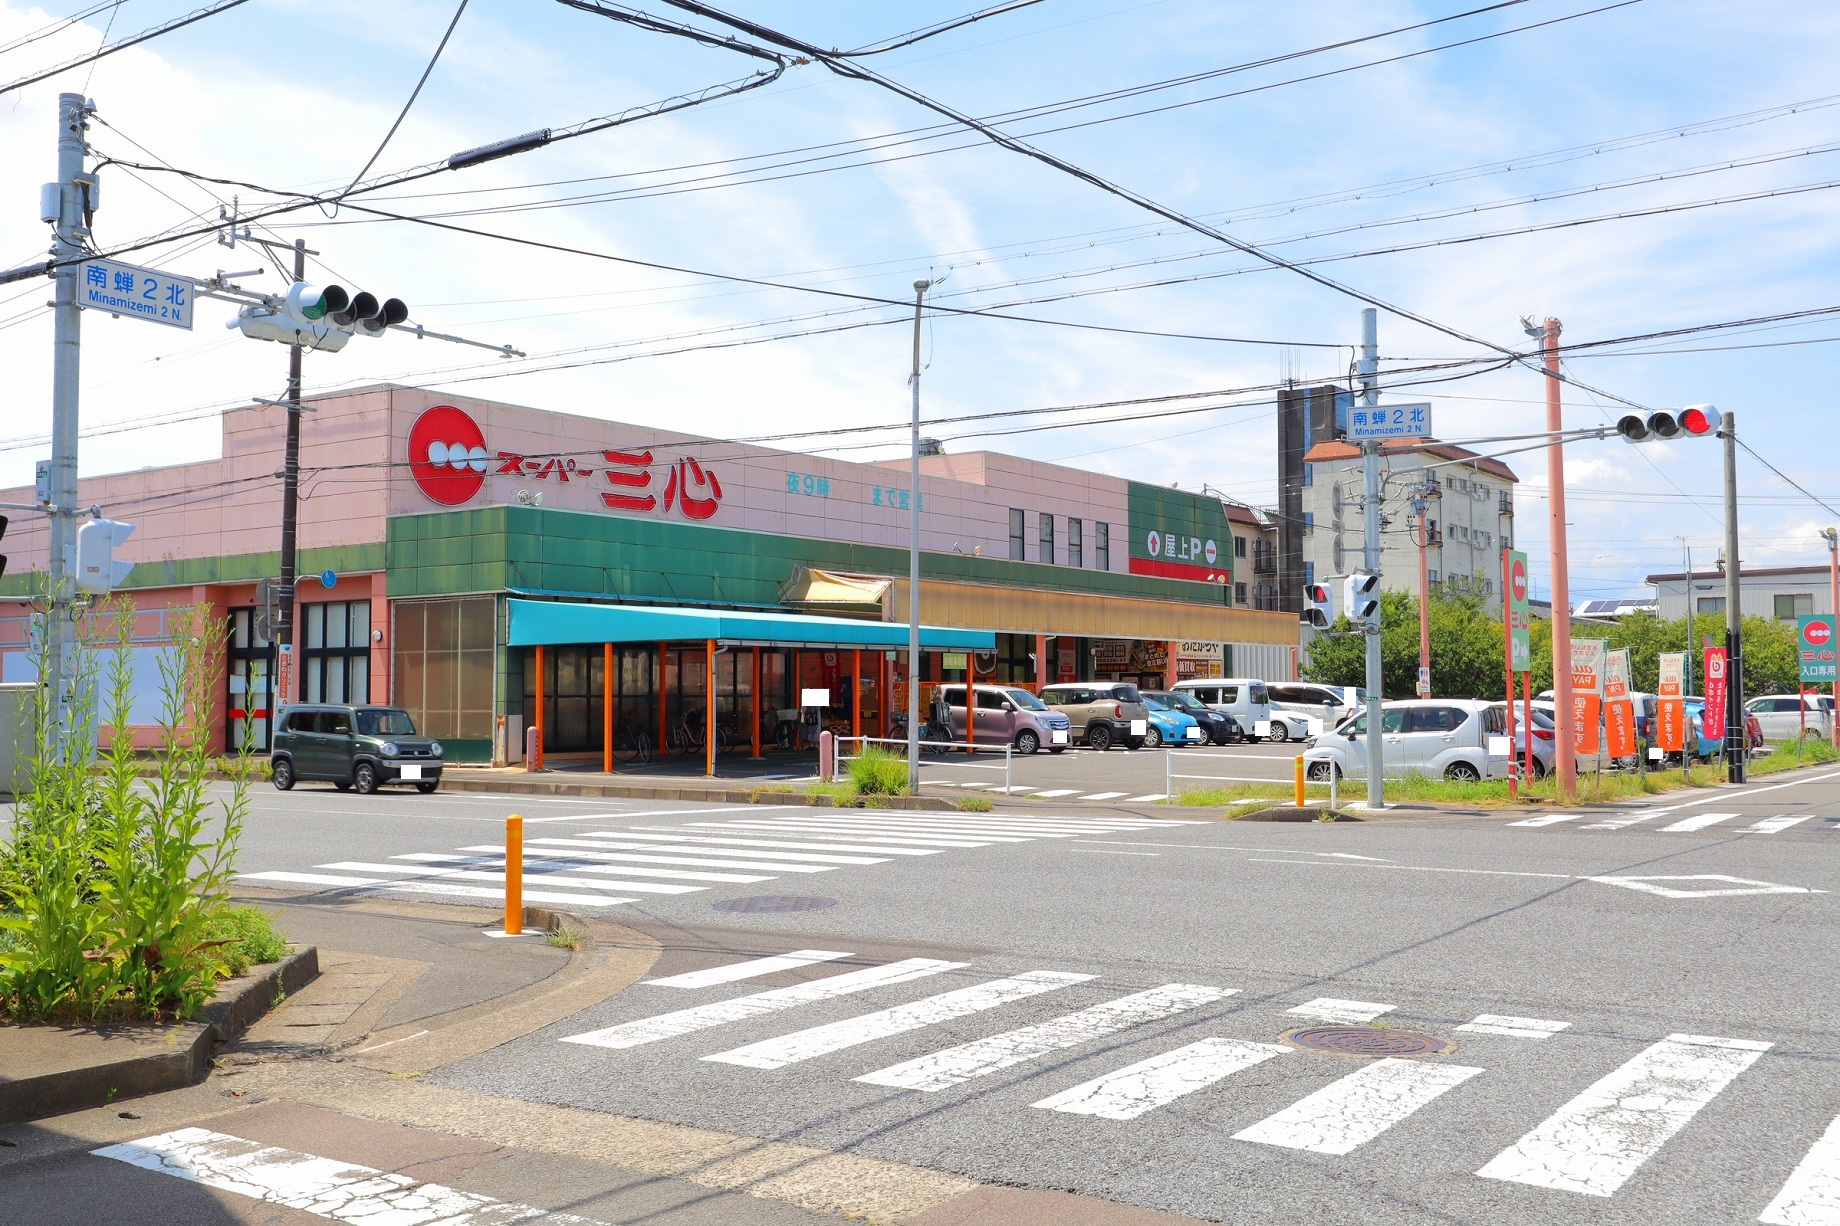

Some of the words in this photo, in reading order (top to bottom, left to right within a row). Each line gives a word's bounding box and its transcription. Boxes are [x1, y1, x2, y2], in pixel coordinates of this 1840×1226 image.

[88, 289, 157, 315] Minamizemi
[161, 306, 168, 317] 2
[1355, 425, 1404, 436] Minamizemi
[1407, 425, 1413, 433] 2
[496, 451, 594, 483] スーパー
[600, 449, 723, 520] 三心
[1800, 650, 1836, 662] 三心
[1801, 665, 1836, 676] 入口専用
